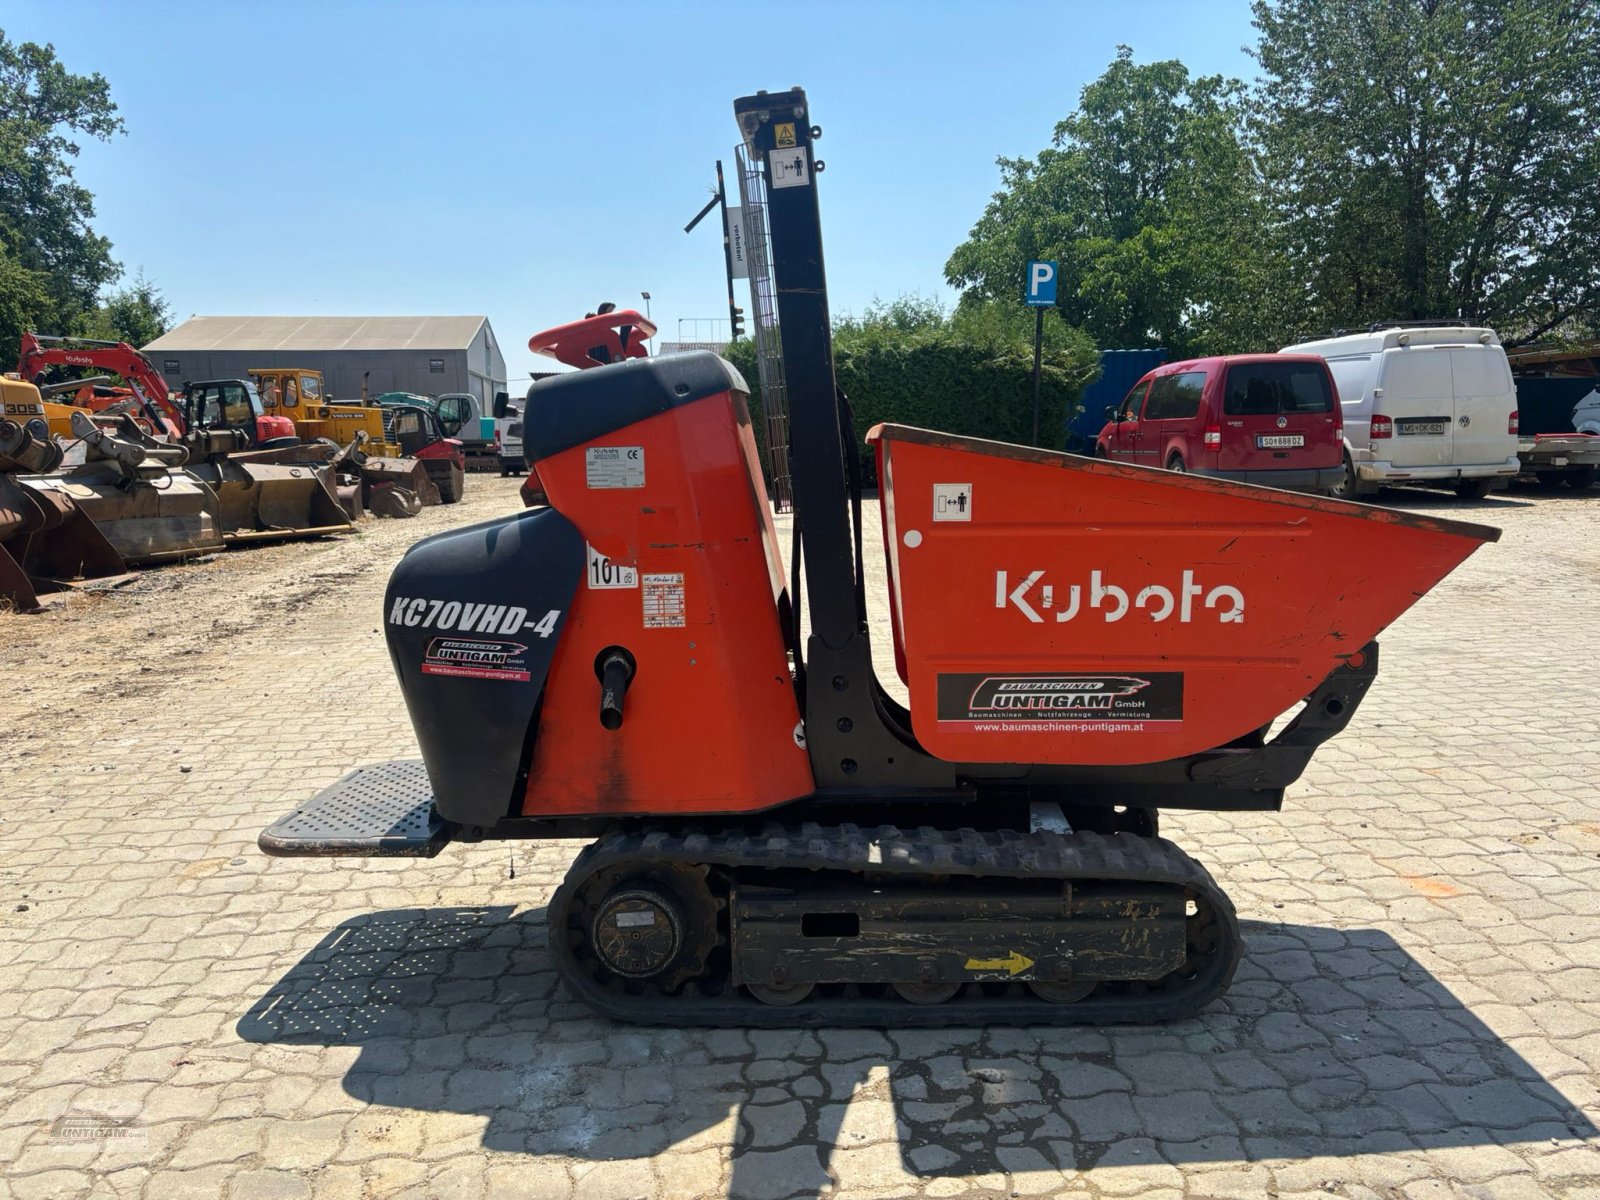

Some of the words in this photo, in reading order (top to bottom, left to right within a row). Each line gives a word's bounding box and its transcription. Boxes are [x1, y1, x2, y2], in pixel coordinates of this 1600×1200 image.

[1031, 263, 1054, 296] P
[65, 355, 93, 364] Kubota
[6, 403, 38, 413] 309
[995, 569, 1245, 624] Kubota
[389, 596, 561, 638] KC70VHD-4
[429, 666, 521, 679] www.baumaschinen-puntigam.at
[1002, 682, 1098, 690] BAUMASCHINEN
[1114, 700, 1146, 708] GmbH
[1107, 711, 1150, 719] Vermietung
[974, 722, 1144, 733] www.baumaschinen-puntigam.at
